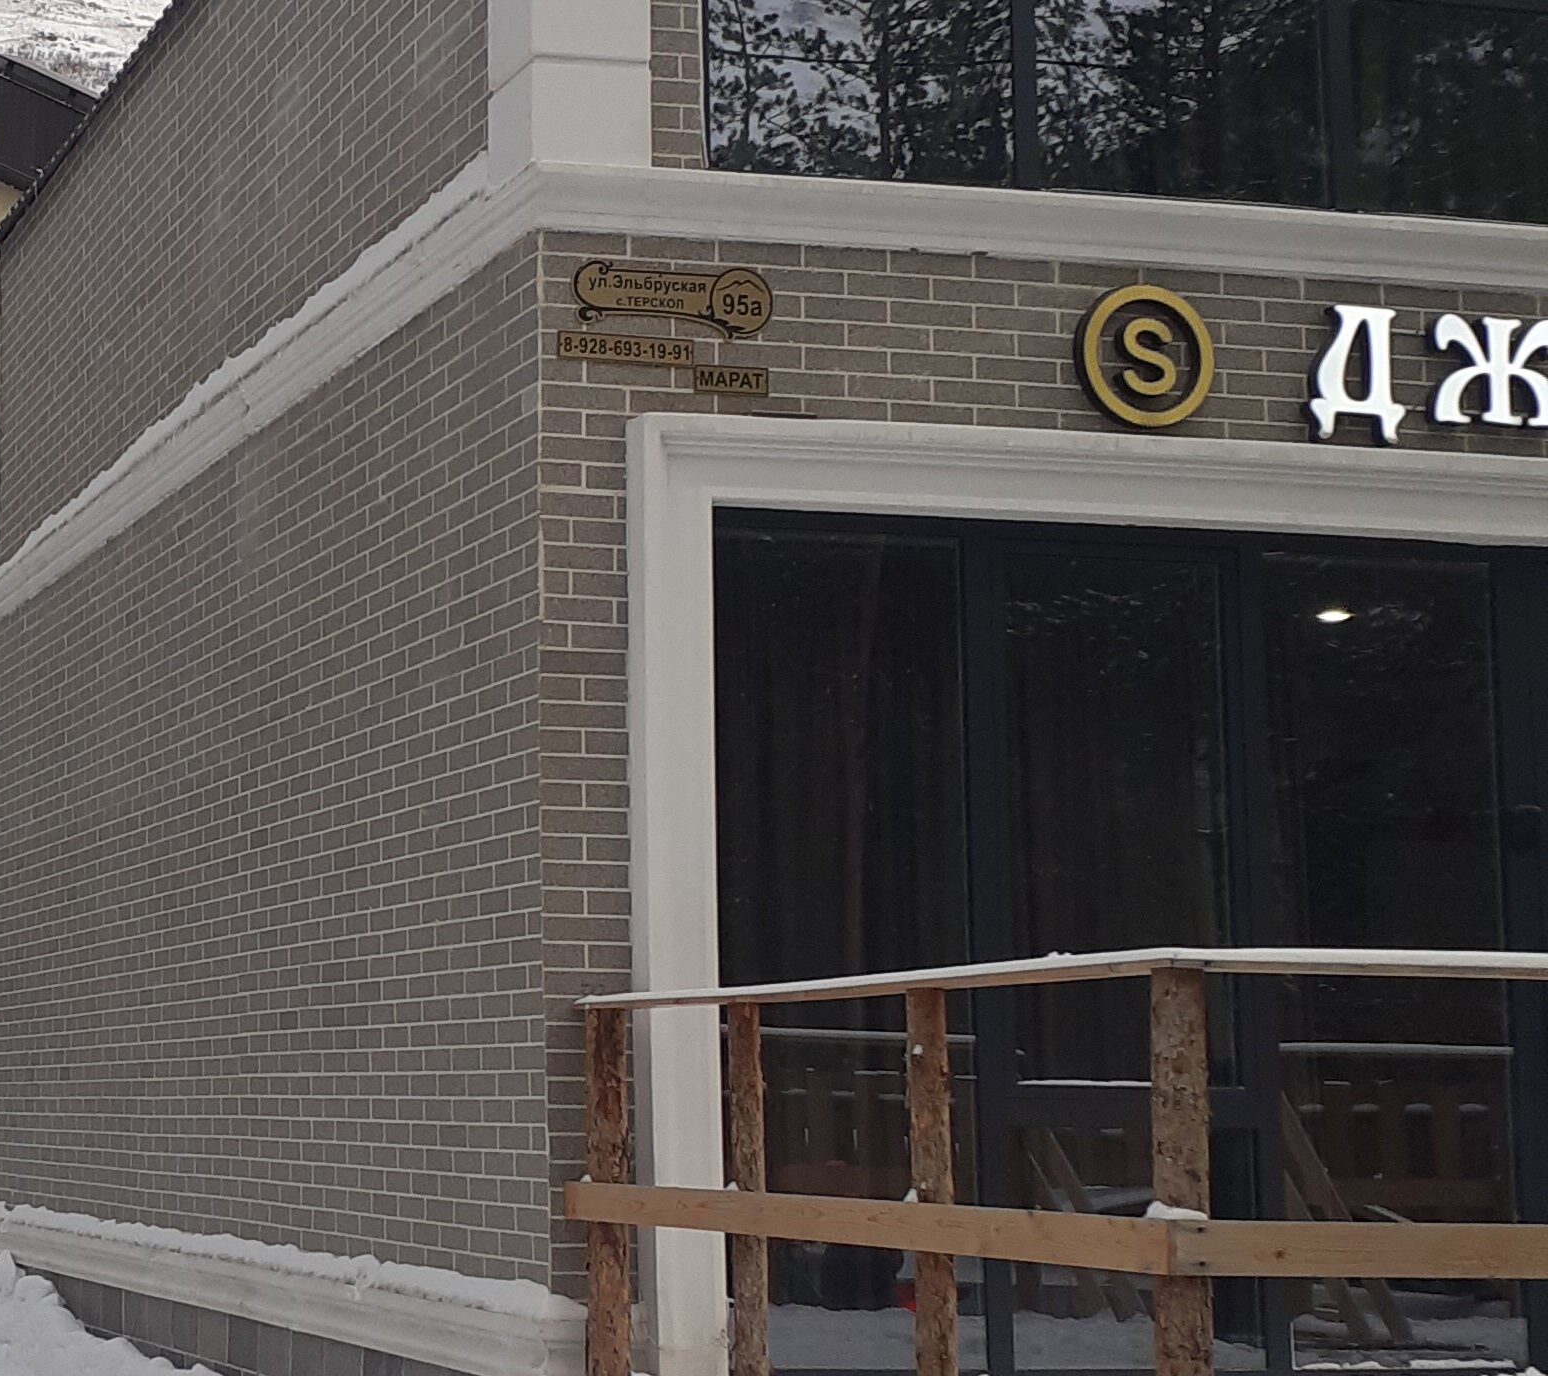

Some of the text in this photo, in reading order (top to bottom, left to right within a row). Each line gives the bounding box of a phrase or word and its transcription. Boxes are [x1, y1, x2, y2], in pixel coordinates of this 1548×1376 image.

[588, 275, 707, 294] ул.Эльбруская
[563, 335, 691, 361] 8-928-693-19-91
[699, 370, 764, 390] МАРАТ
